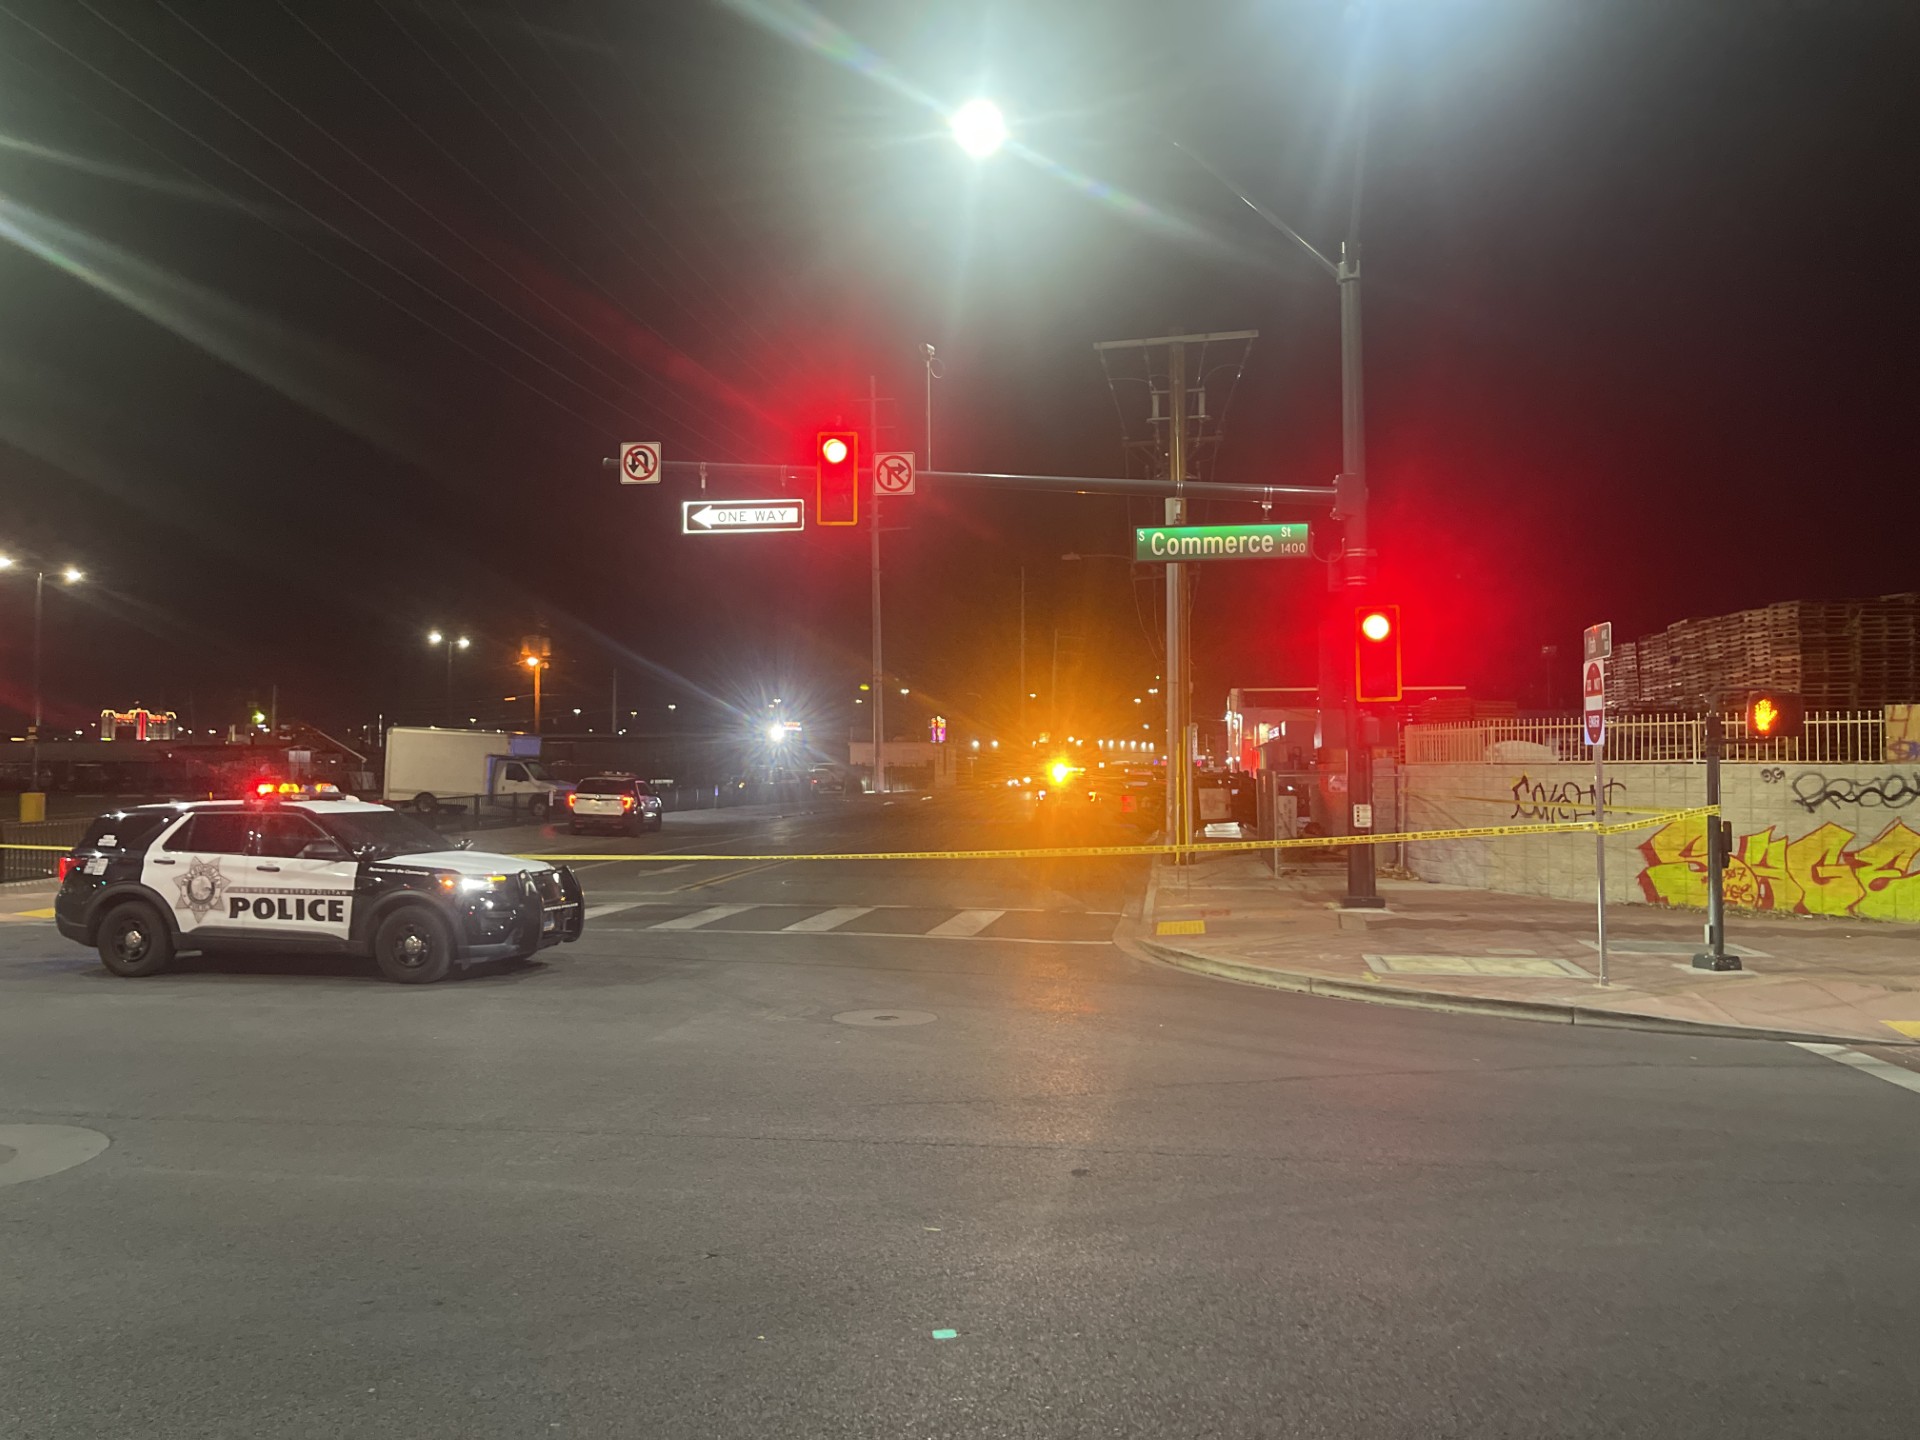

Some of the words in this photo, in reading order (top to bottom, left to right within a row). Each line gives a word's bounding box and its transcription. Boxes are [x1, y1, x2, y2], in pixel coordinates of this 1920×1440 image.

[717, 511, 747, 522] ONE
[754, 510, 787, 521] WAY
[1138, 531, 1145, 542] S
[1151, 530, 1274, 556] Commerce
[1281, 526, 1291, 537] St
[1281, 543, 1306, 554] 1400
[229, 897, 344, 922] POLICE
